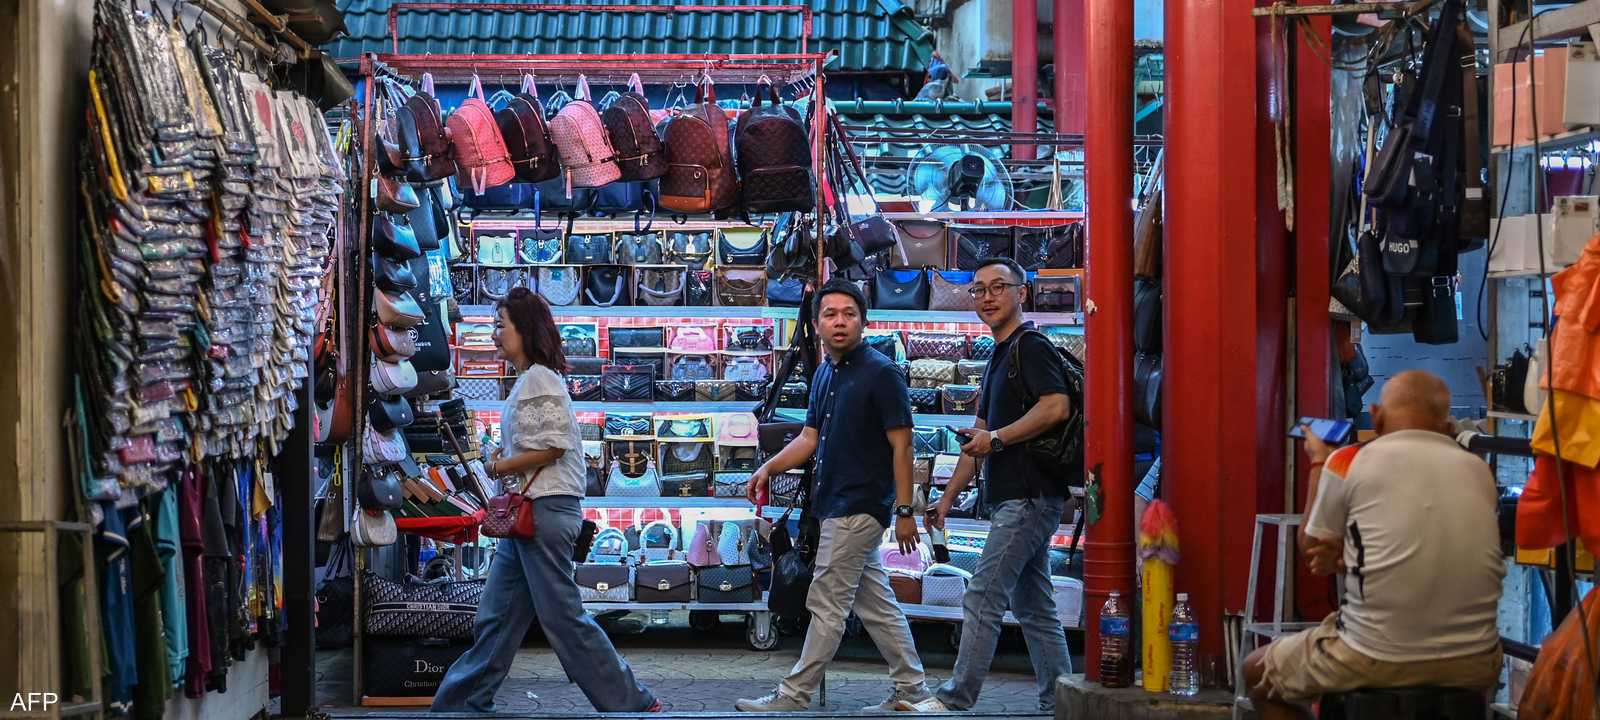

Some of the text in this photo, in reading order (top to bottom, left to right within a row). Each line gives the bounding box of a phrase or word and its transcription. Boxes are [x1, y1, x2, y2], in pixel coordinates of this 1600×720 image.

[1389, 242, 1409, 253] HUGO
[413, 659, 445, 673] Dior
[404, 680, 437, 688] Christian
